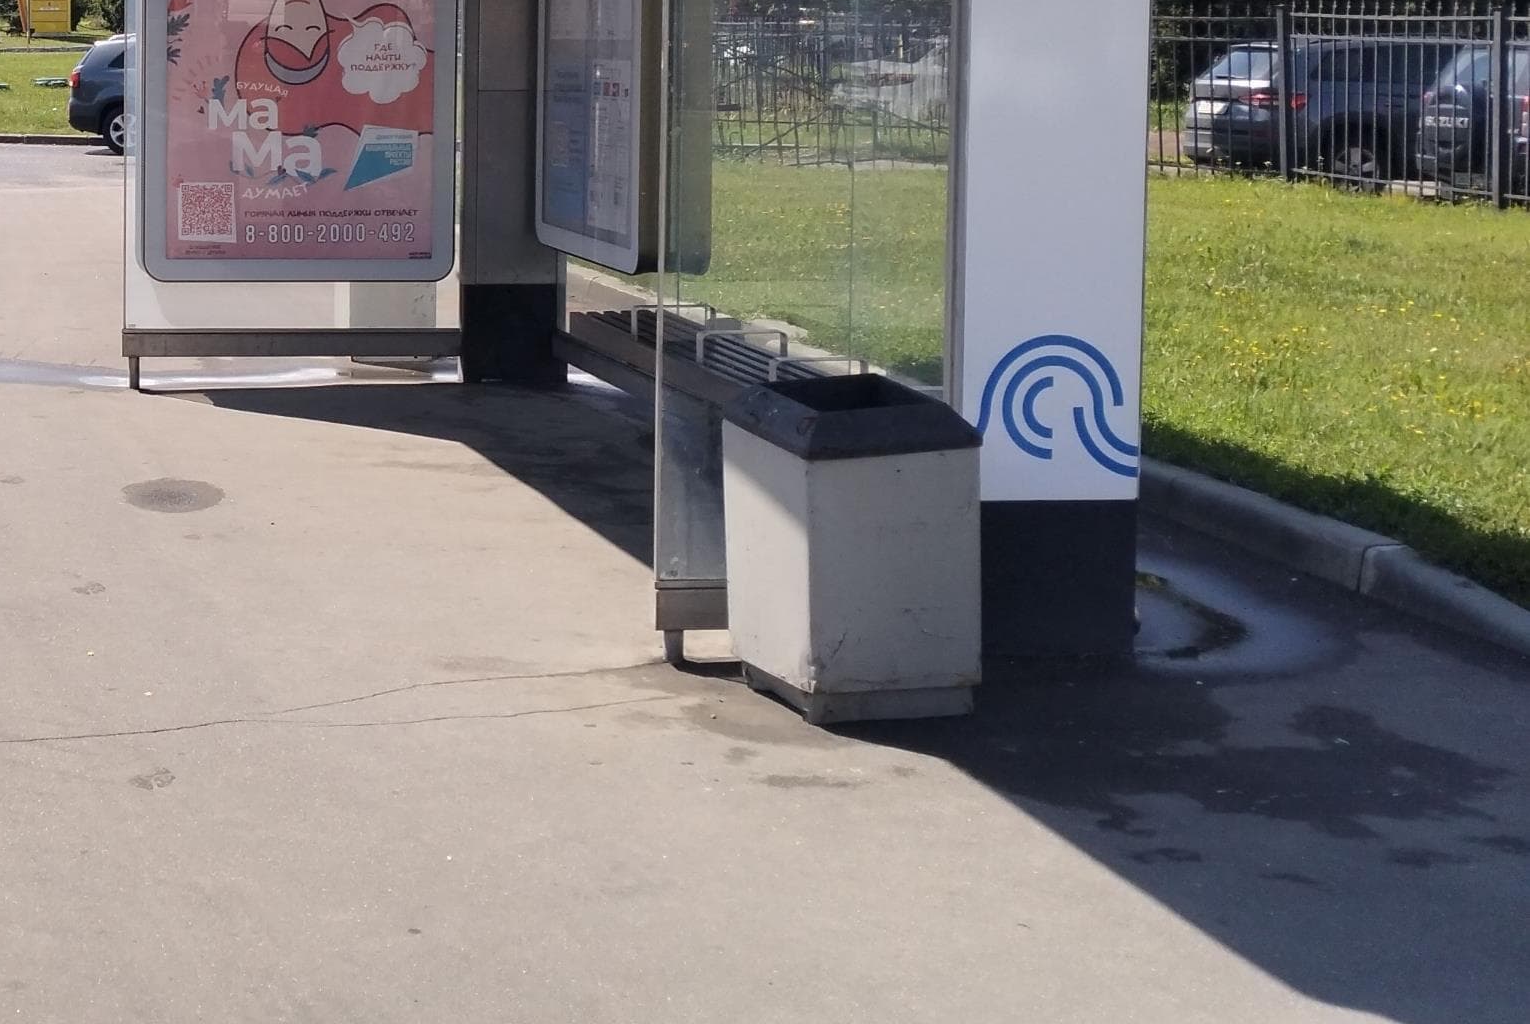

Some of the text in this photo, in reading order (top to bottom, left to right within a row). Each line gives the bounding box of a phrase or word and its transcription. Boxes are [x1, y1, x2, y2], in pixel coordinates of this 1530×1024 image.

[374, 42, 394, 52] ГДЕ
[365, 53, 402, 62] НАЙТИ
[242, 182, 309, 199] ДУМАЕТ
[319, 209, 372, 218] ПОДДЕРЖКИ
[374, 209, 419, 217] ОТВЕЧАЕТ
[245, 222, 415, 243] 8-800-2000-492
